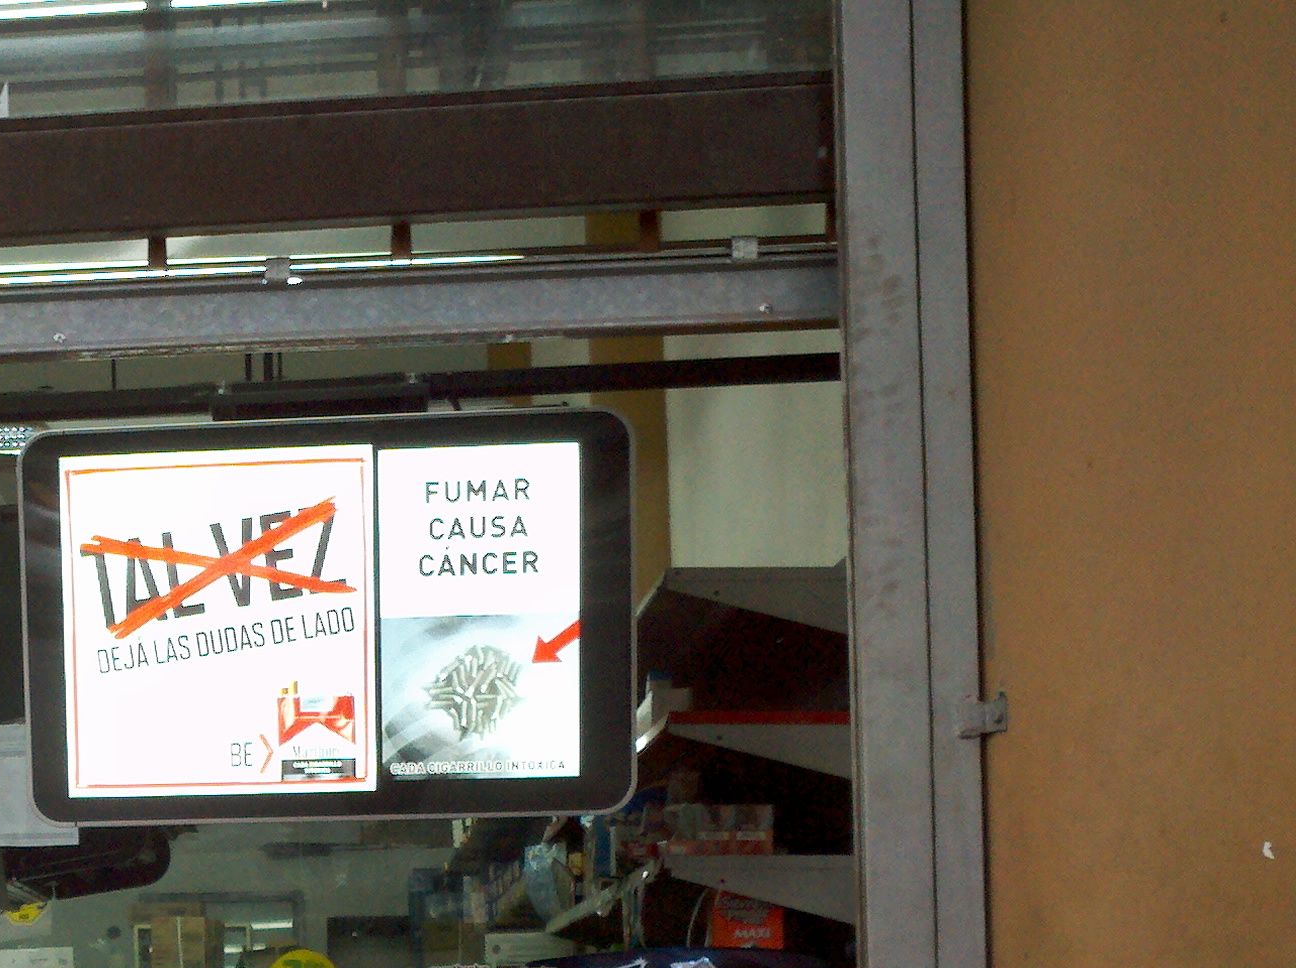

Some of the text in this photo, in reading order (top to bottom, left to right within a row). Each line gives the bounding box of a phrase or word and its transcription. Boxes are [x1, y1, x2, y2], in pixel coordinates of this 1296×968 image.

[425, 478, 531, 503] FUMAR
[429, 515, 528, 540] CAUSA
[419, 547, 539, 577] CÁNCER
[97, 607, 356, 674] DEJÁ LAS DUDAS DE LADO
[230, 742, 254, 767] BE
